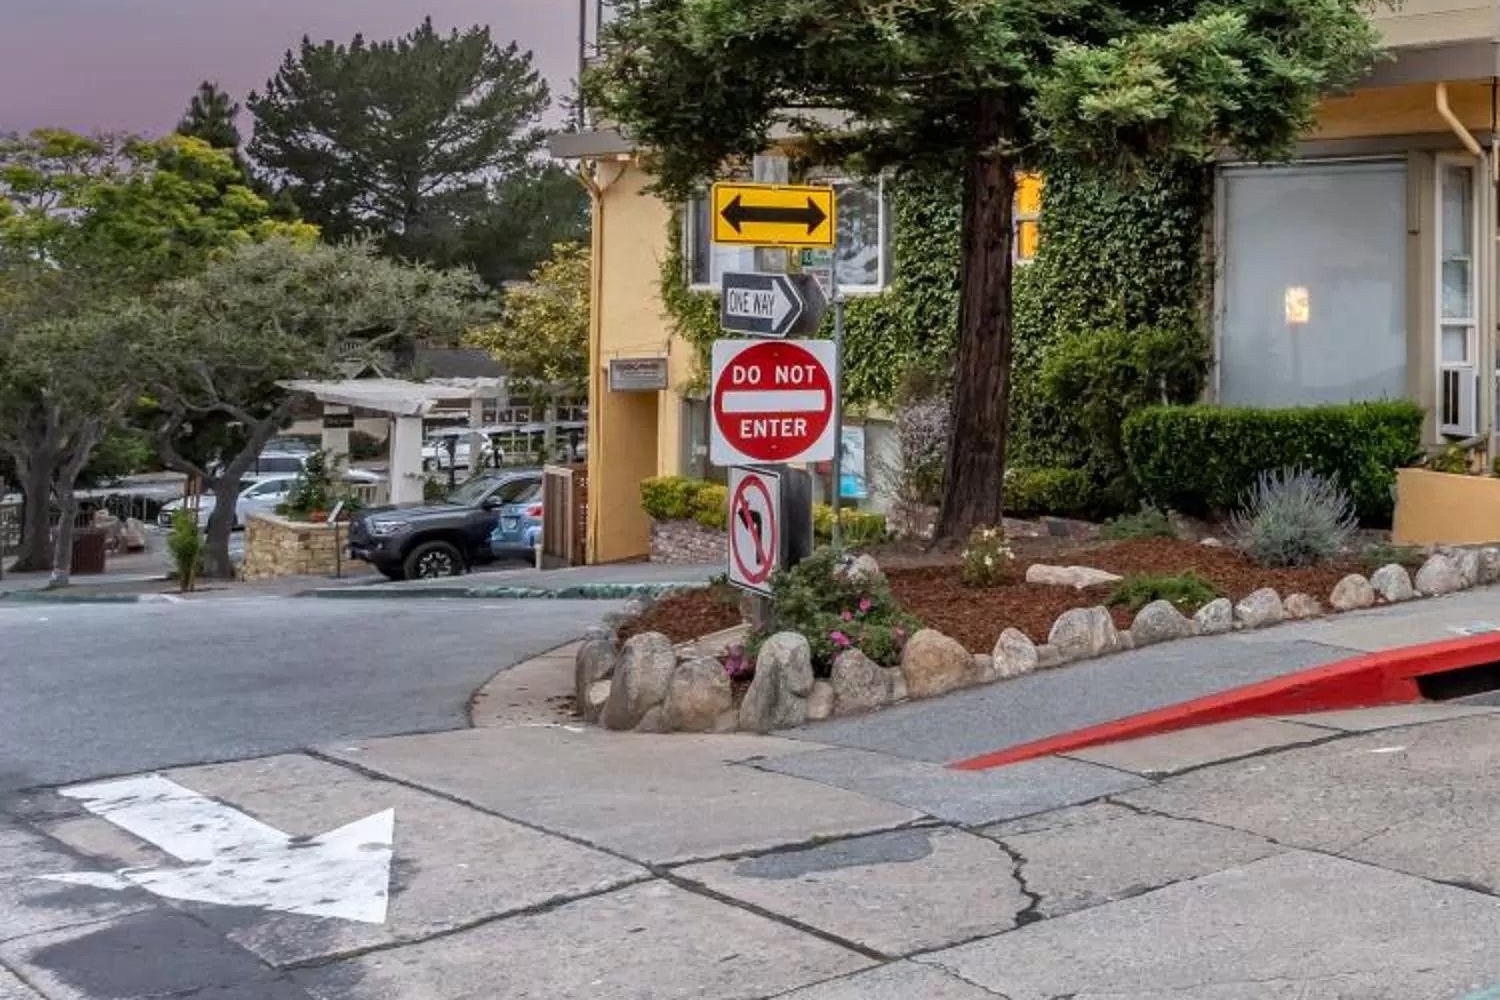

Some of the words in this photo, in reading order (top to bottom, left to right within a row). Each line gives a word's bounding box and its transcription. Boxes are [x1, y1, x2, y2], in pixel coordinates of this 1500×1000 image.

[730, 290, 749, 313] ONE
[754, 293, 775, 316] WAY
[733, 365, 761, 385] DO
[775, 365, 817, 384] NOT
[741, 418, 808, 439] ENTER
